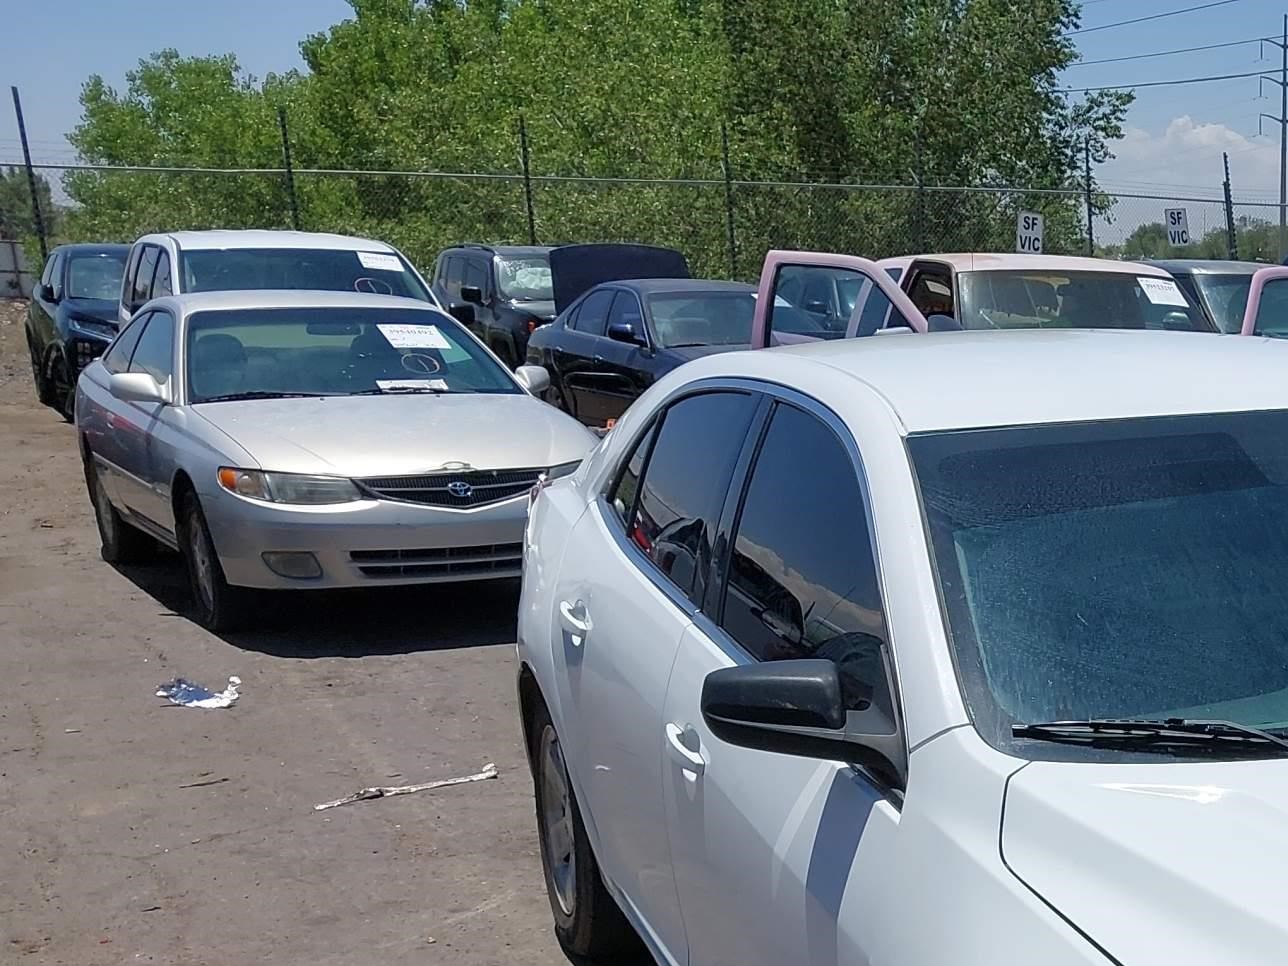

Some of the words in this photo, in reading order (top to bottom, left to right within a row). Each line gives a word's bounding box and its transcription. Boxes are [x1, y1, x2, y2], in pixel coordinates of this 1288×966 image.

[1023, 215, 1039, 231] SF
[1170, 211, 1183, 225] SF
[1019, 234, 1041, 251] VIC
[1169, 230, 1188, 245] VIC
